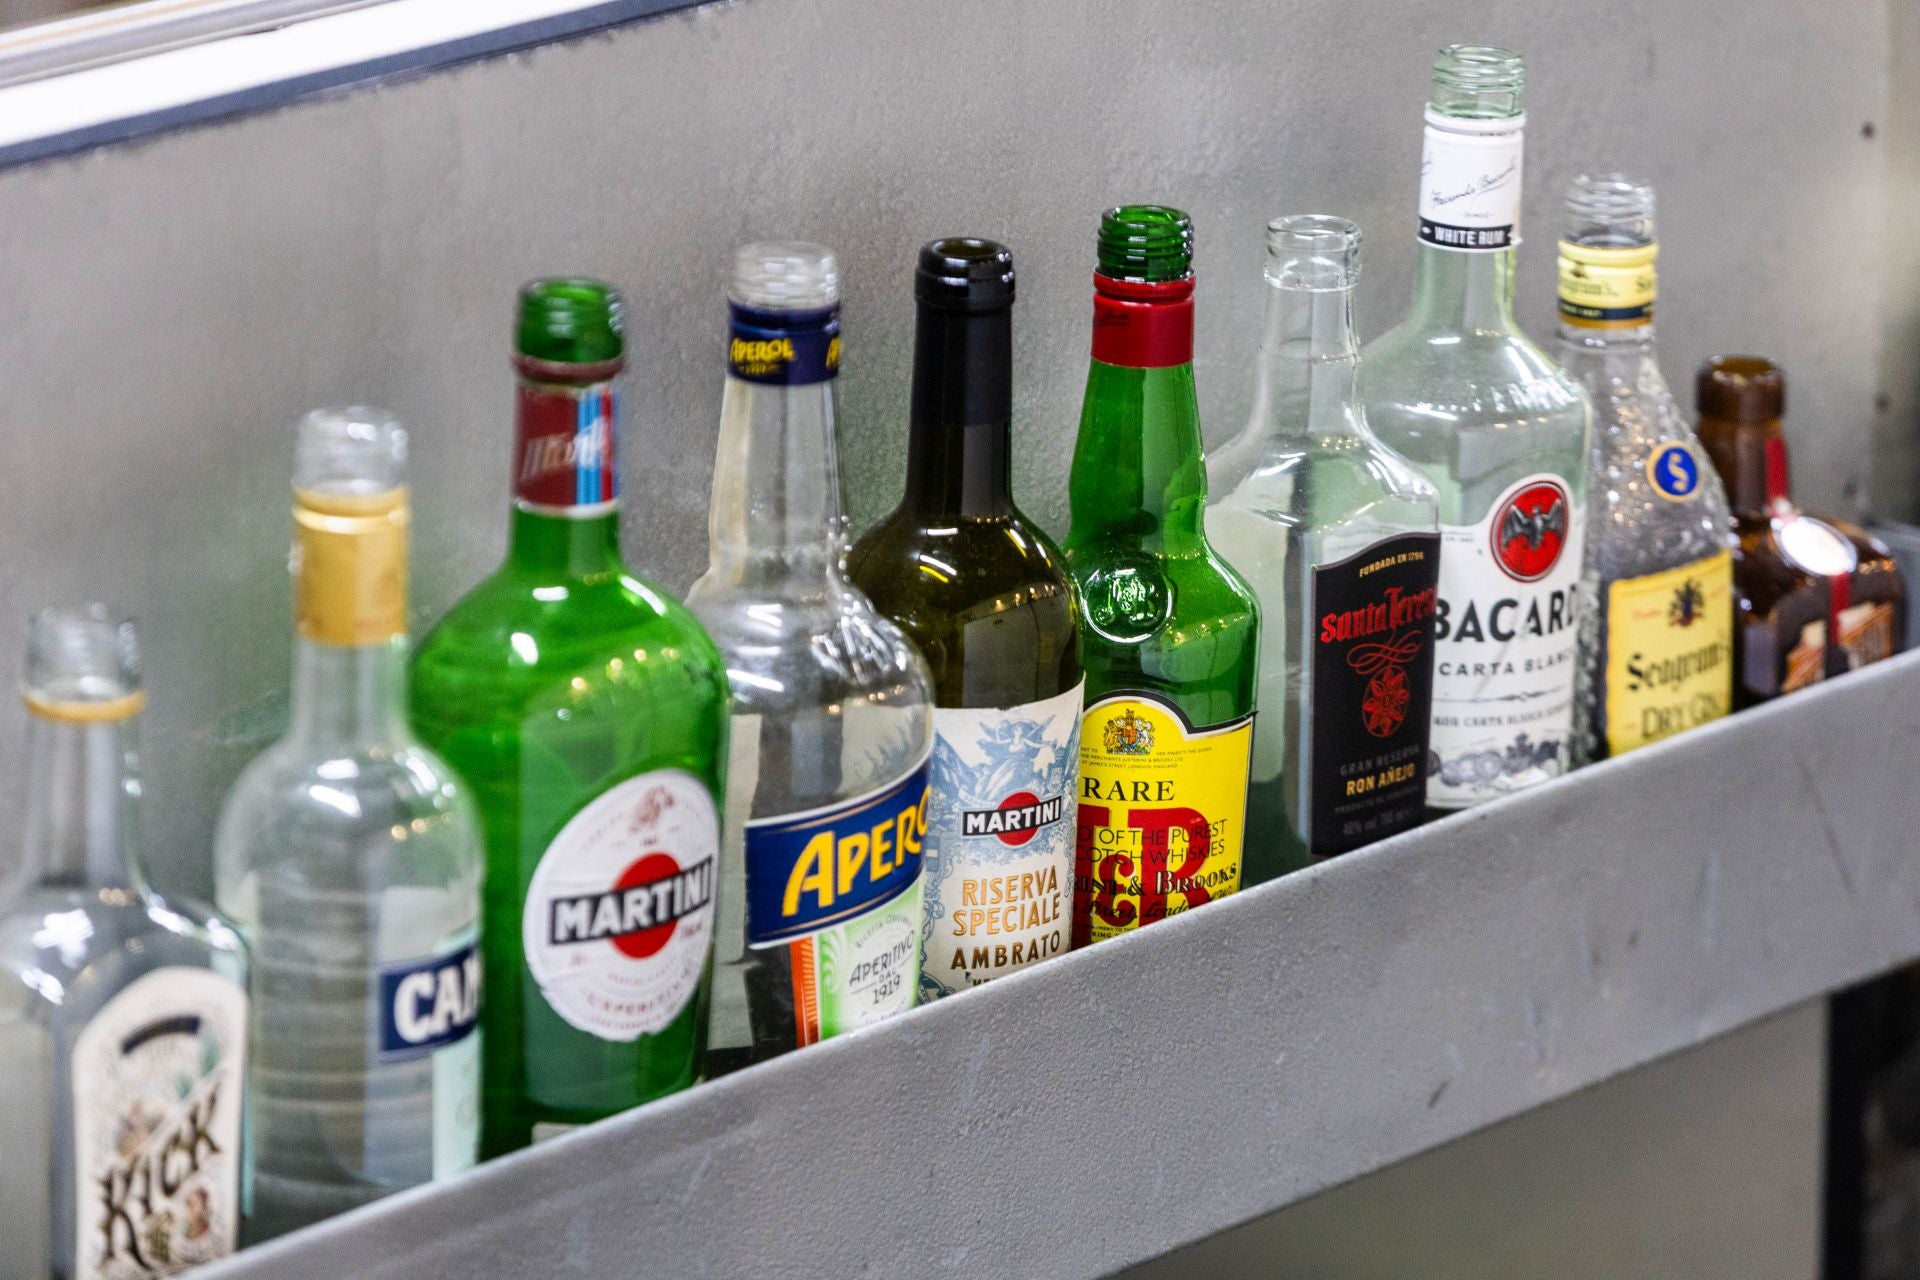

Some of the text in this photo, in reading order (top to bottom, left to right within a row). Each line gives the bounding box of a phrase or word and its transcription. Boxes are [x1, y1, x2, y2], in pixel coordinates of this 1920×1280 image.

[1434, 226, 1505, 245] WHITE RUM
[730, 338, 795, 363] APEROL
[1359, 556, 1396, 578] FUNDADA
[1397, 553, 1407, 564] EN
[1439, 661, 1515, 676] CARTA
[1081, 775, 1176, 802] RARE
[1346, 762, 1415, 796] RON AÑEJO
[965, 798, 1061, 835] MARTINI
[1098, 828, 1126, 845] OF
[1128, 829, 1166, 846] THE
[1172, 818, 1229, 845] PUREST
[1150, 838, 1226, 865] WHISKIES
[961, 864, 1058, 907] RISERVA
[553, 862, 711, 942] MARTINI
[952, 891, 1061, 936] SPECIALE
[950, 930, 1060, 970] AMBRATO
[872, 974, 901, 1005] 1919
